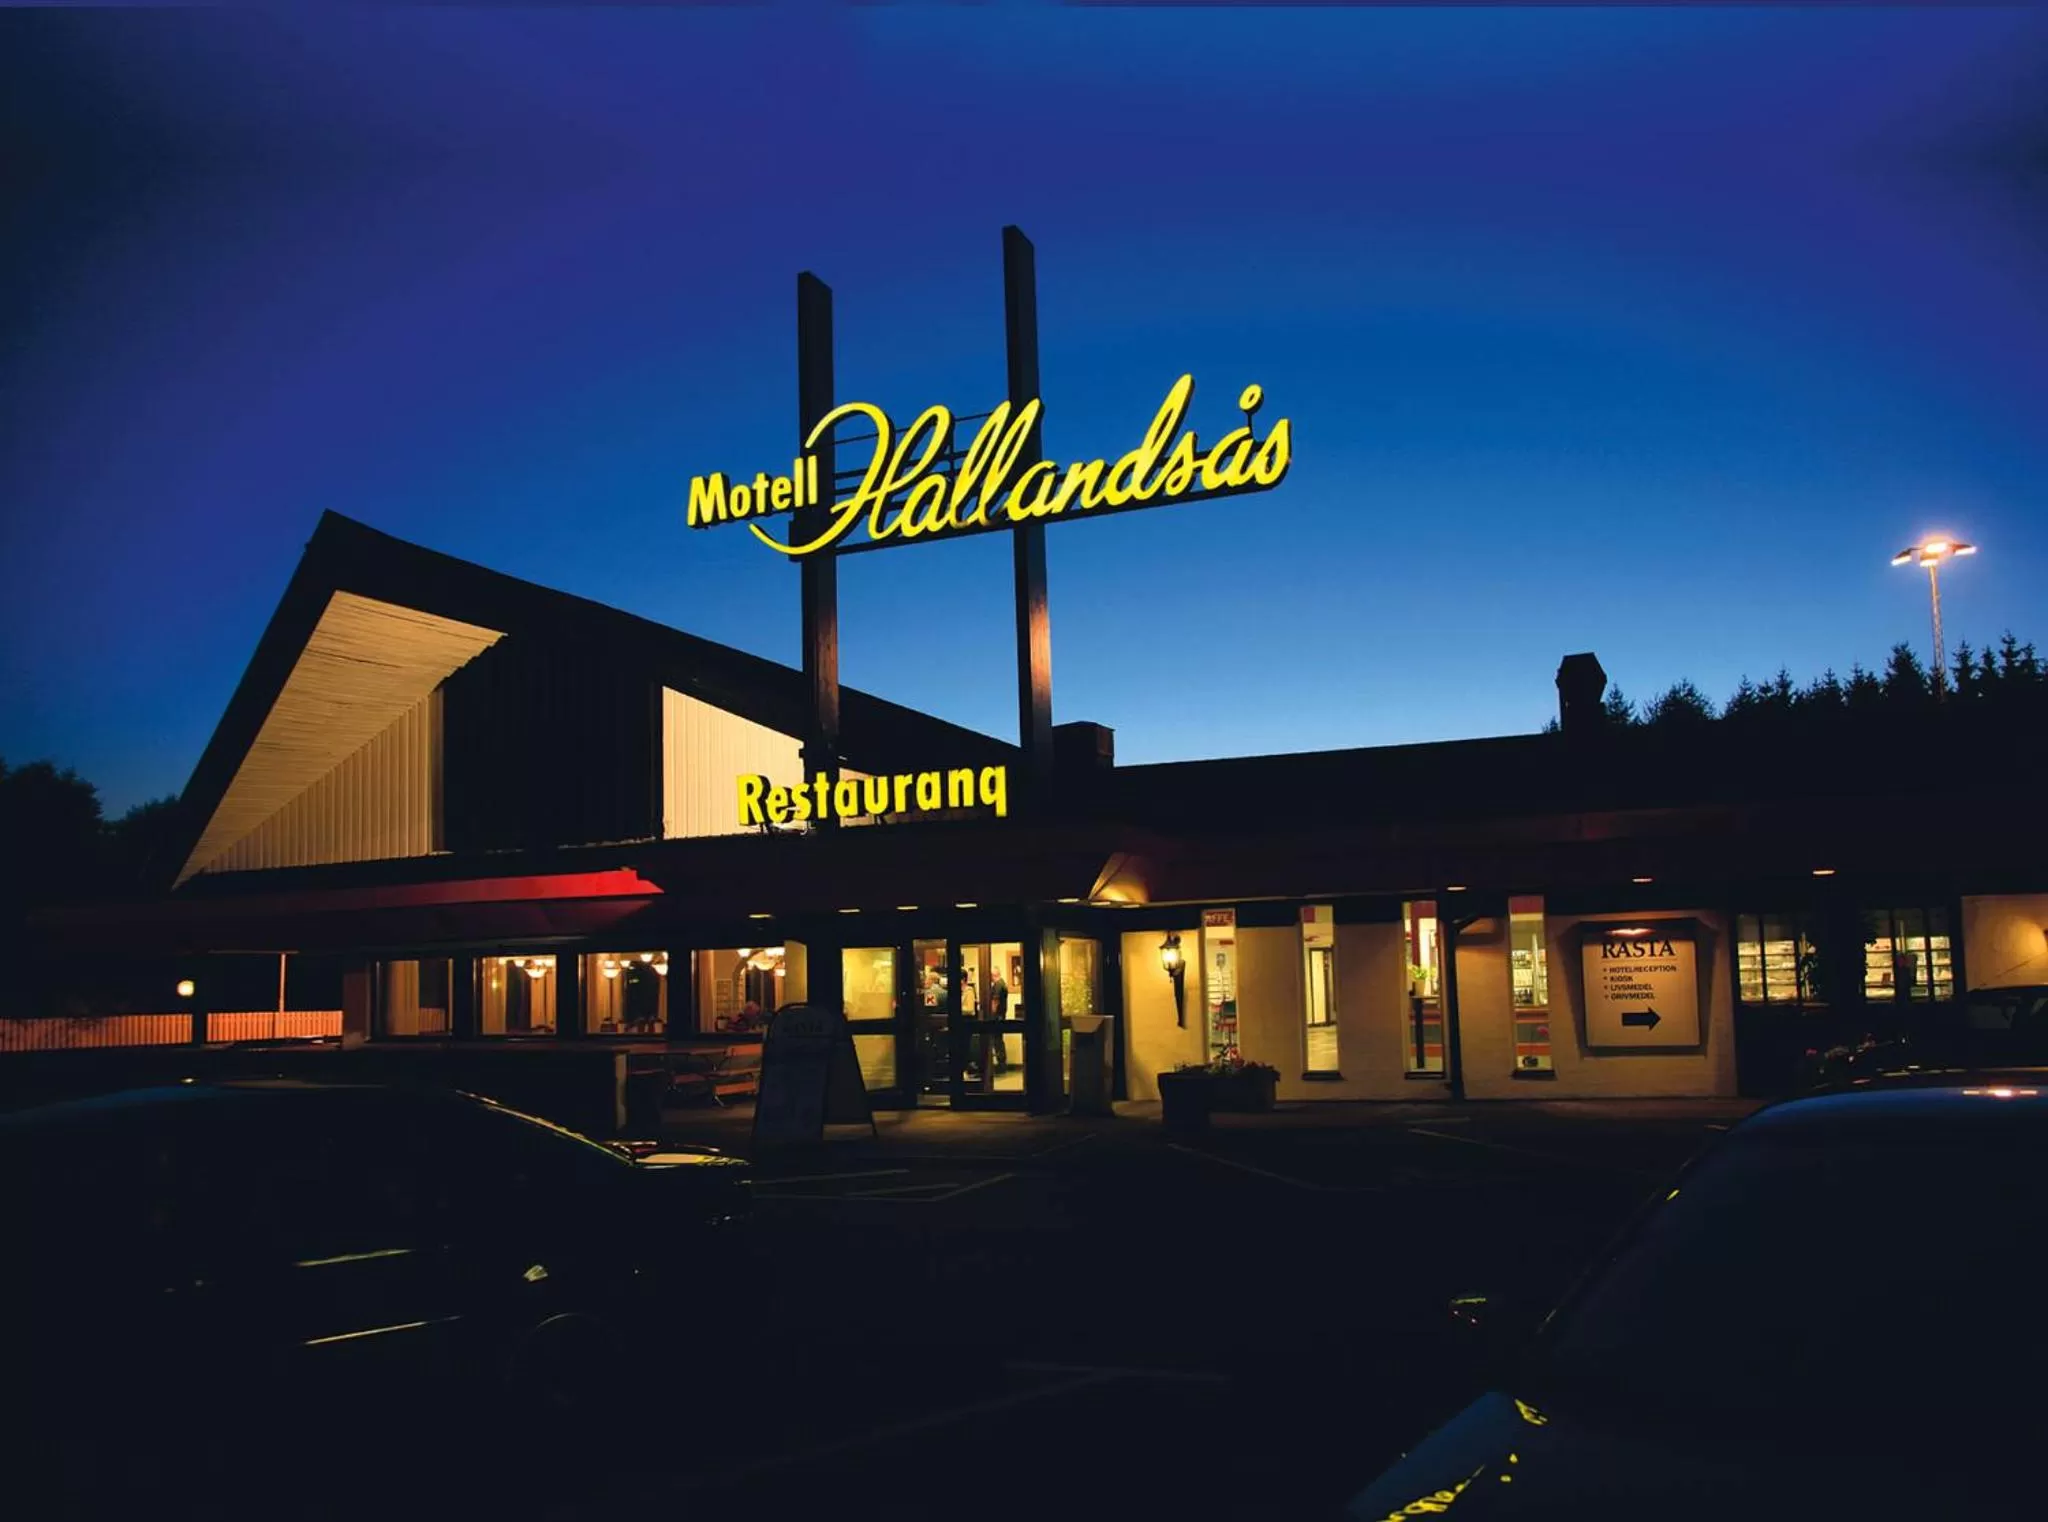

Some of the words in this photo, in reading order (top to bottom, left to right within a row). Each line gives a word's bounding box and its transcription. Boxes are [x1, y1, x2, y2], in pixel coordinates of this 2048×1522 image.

[749, 373, 1291, 555] Hallandsås
[687, 454, 818, 527] Motell
[1602, 940, 1676, 958] RASTA
[1609, 965, 1677, 973] HOTELRECEPTION
